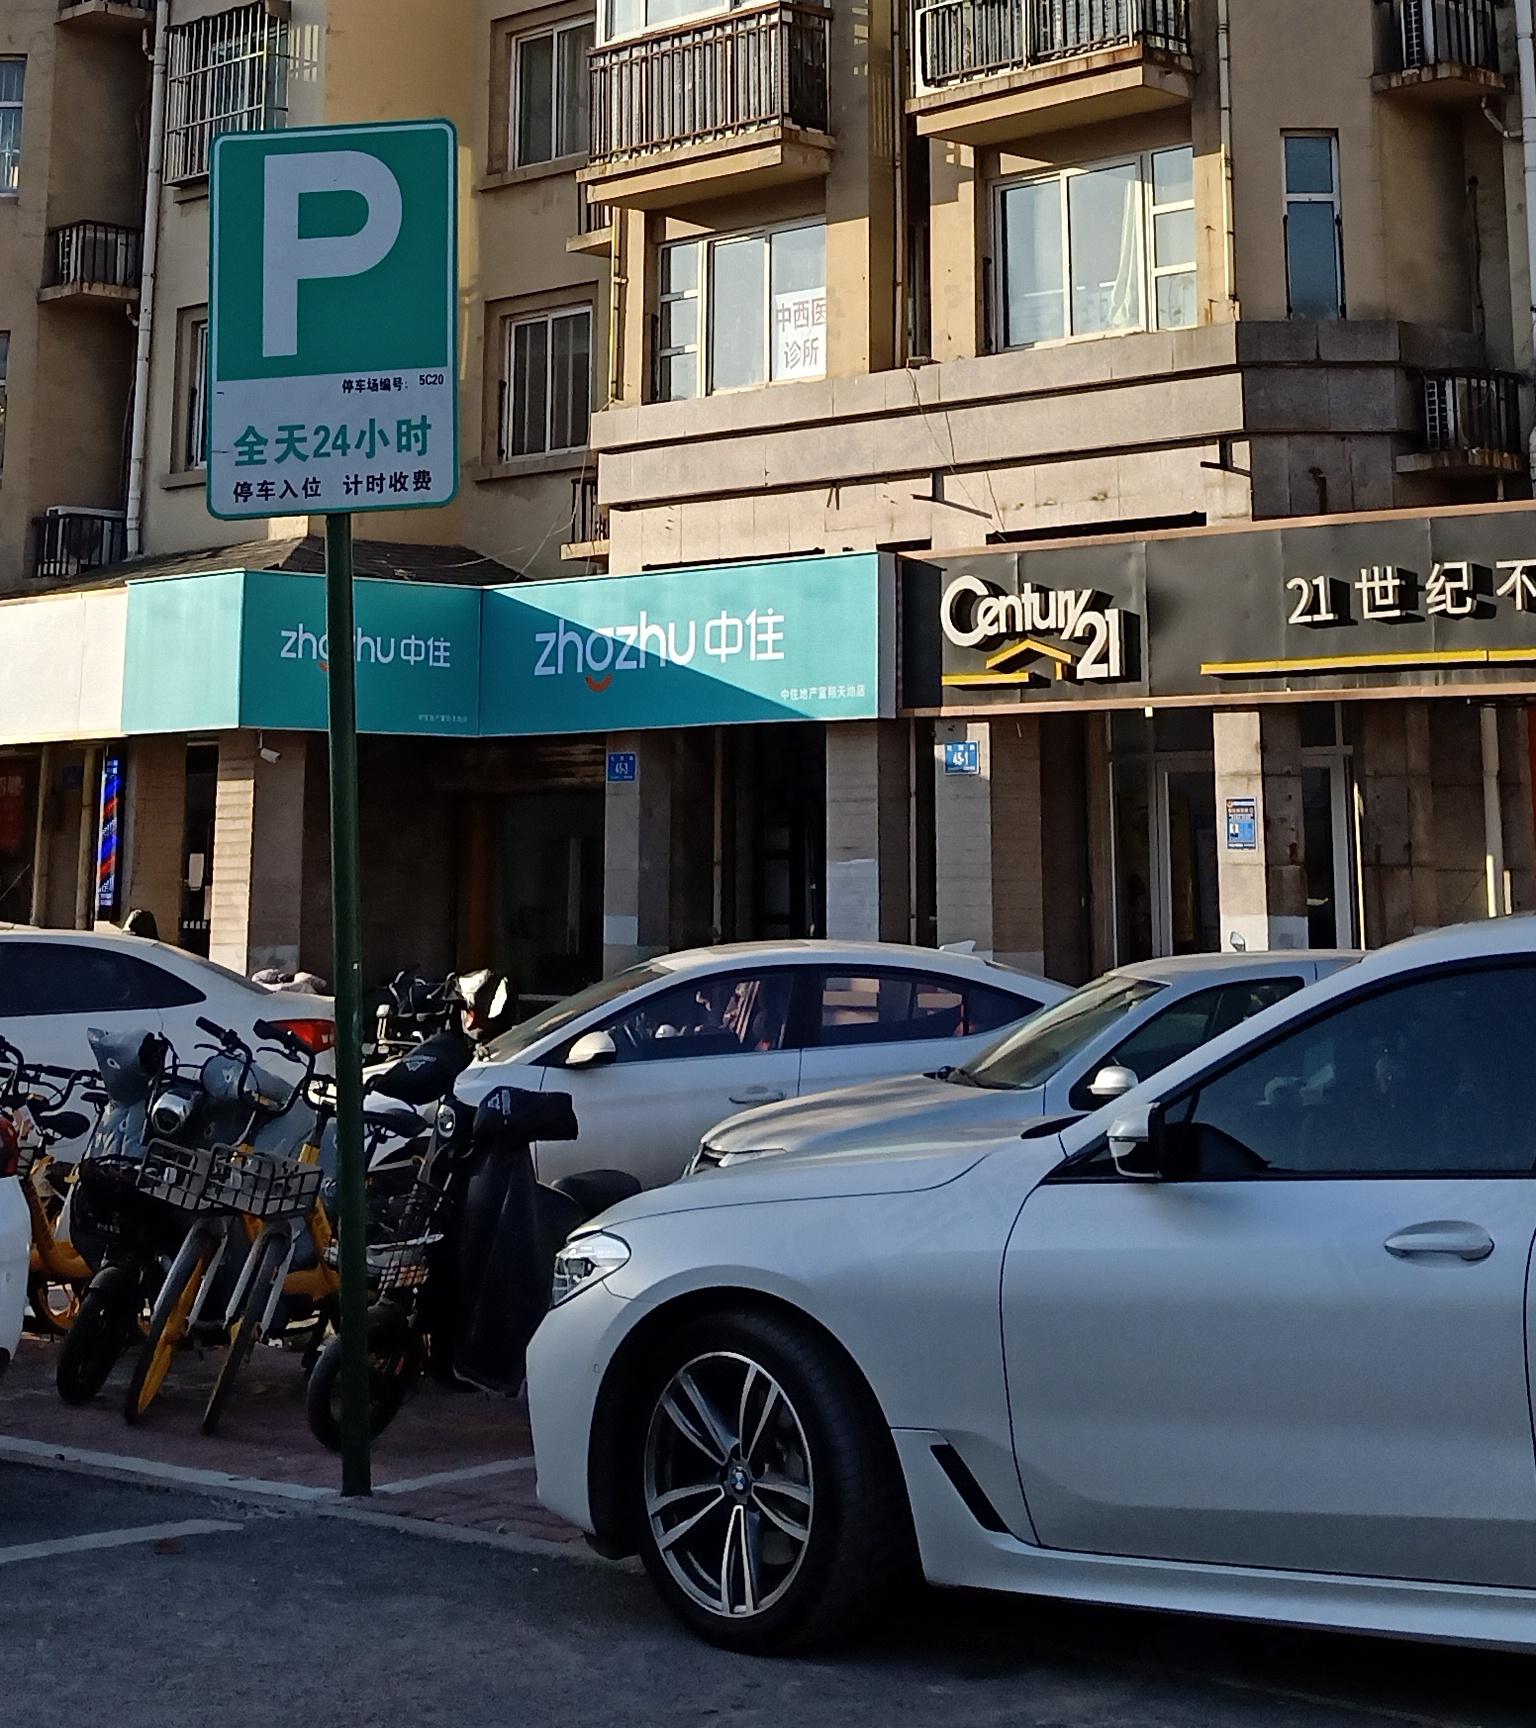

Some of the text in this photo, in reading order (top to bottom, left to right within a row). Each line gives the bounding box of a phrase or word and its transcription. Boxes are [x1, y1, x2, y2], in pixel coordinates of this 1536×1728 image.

[263, 150, 403, 358] P
[776, 297, 826, 333] 中西医
[784, 337, 819, 369] 诊所
[419, 374, 444, 386] 5C20
[233, 415, 432, 467] 全天24小时
[233, 470, 433, 503] 停车入位 计时收费
[534, 607, 785, 676] zhozhu 中住
[940, 575, 1121, 680] Century 21
[400, 634, 451, 668] 中住
